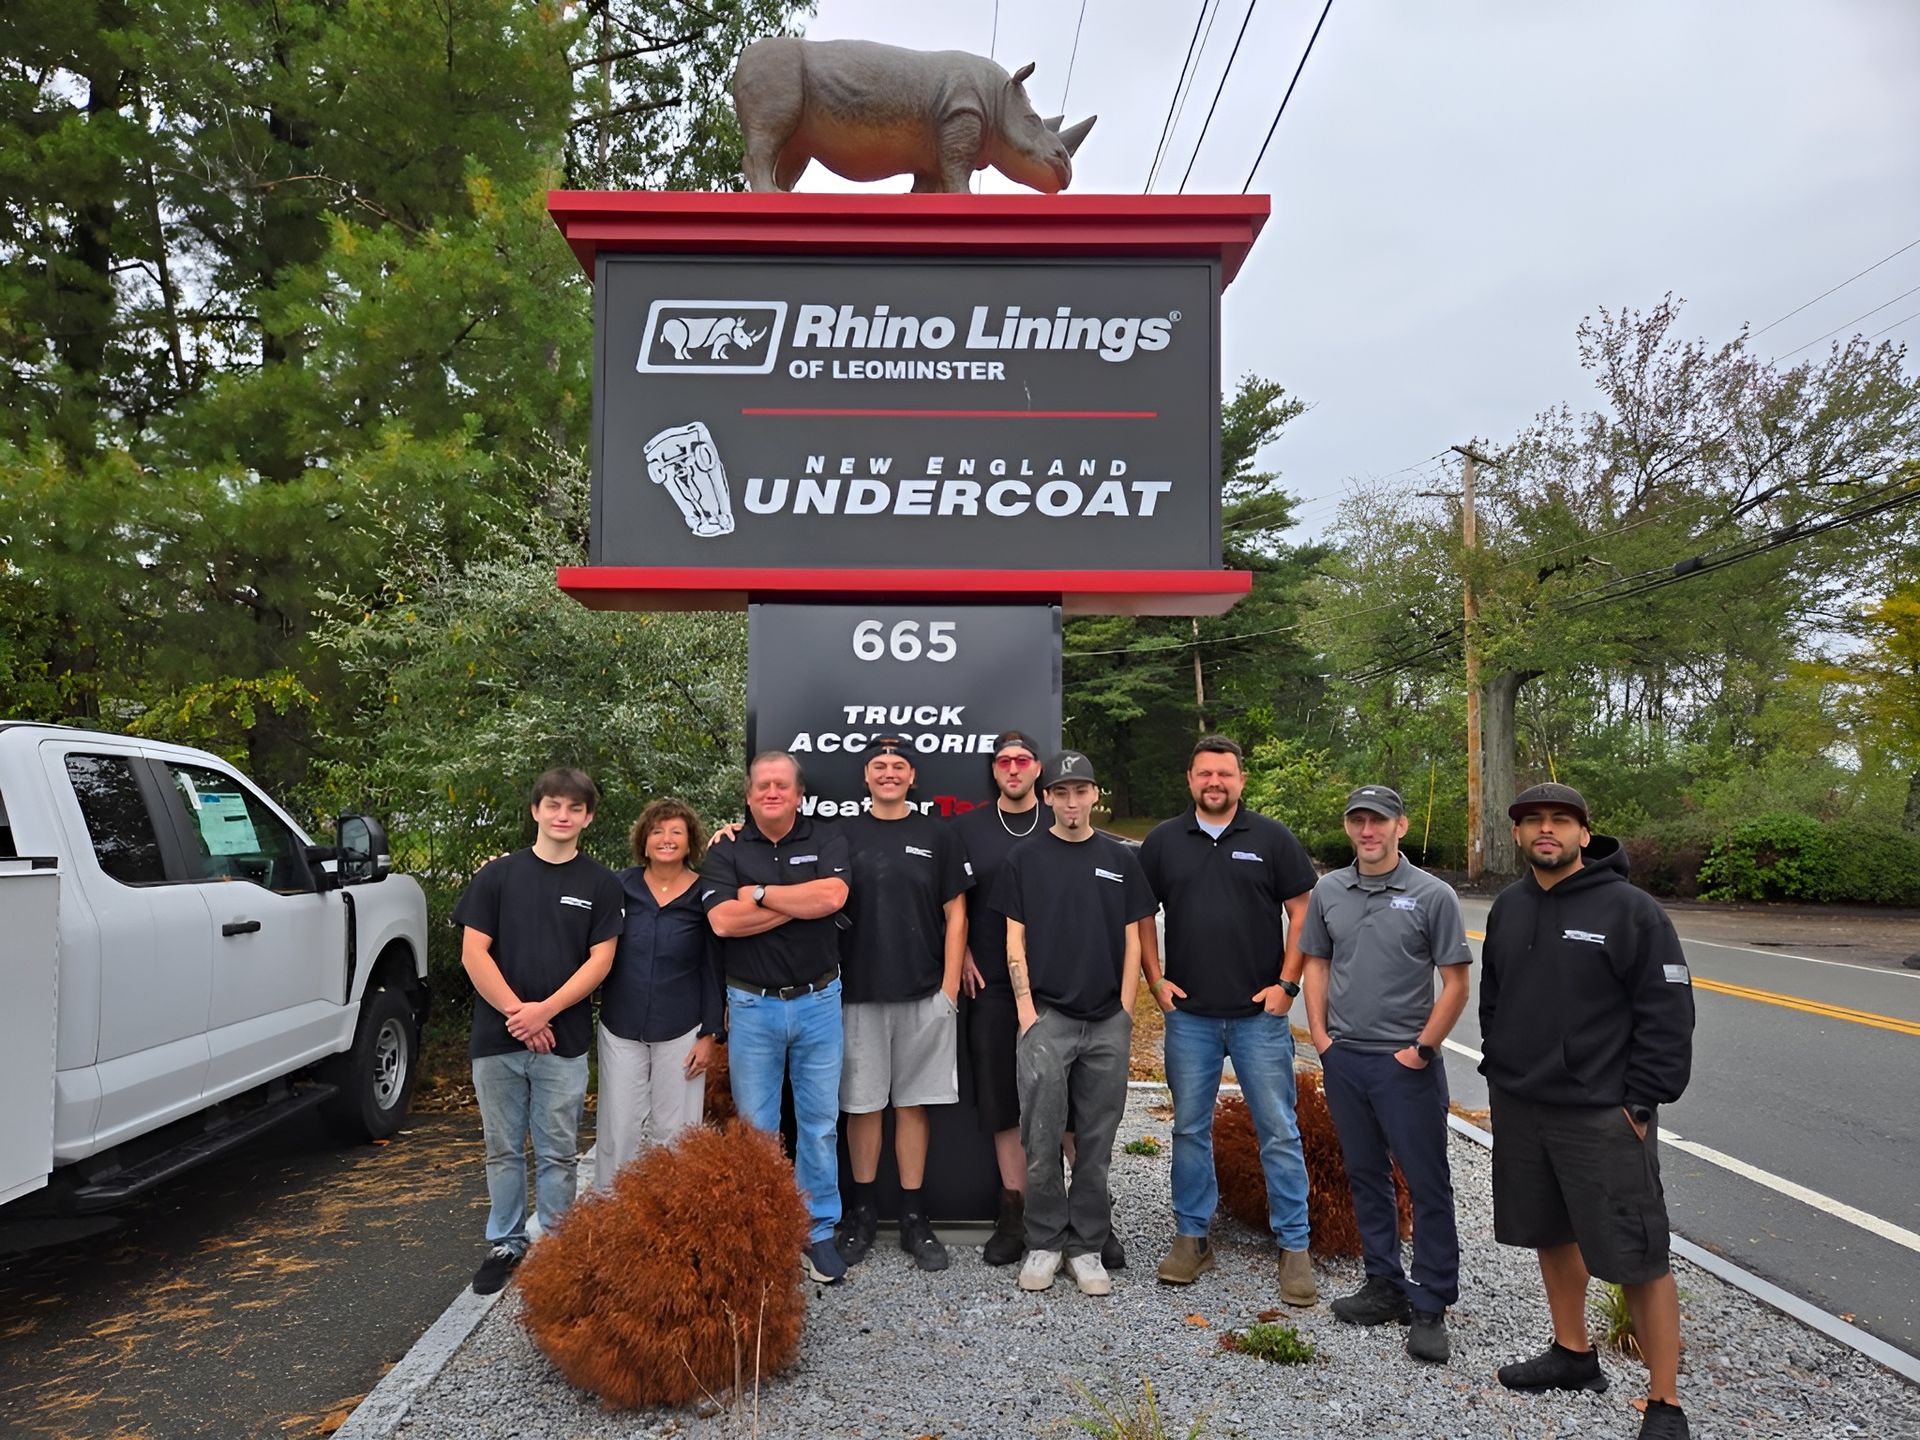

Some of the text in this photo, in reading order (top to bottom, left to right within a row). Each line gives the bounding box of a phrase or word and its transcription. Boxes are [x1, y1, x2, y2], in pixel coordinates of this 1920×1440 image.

[792, 304, 1172, 362] Rhino Linings
[789, 360, 1006, 381] OF LEOMINSTER
[806, 456, 1127, 476] NEW ENGLAND
[743, 478, 1172, 517] UNDERCOAT
[852, 619, 958, 663] 665
[843, 705, 966, 726] TRUCK
[787, 732, 999, 753] ACCORIE
